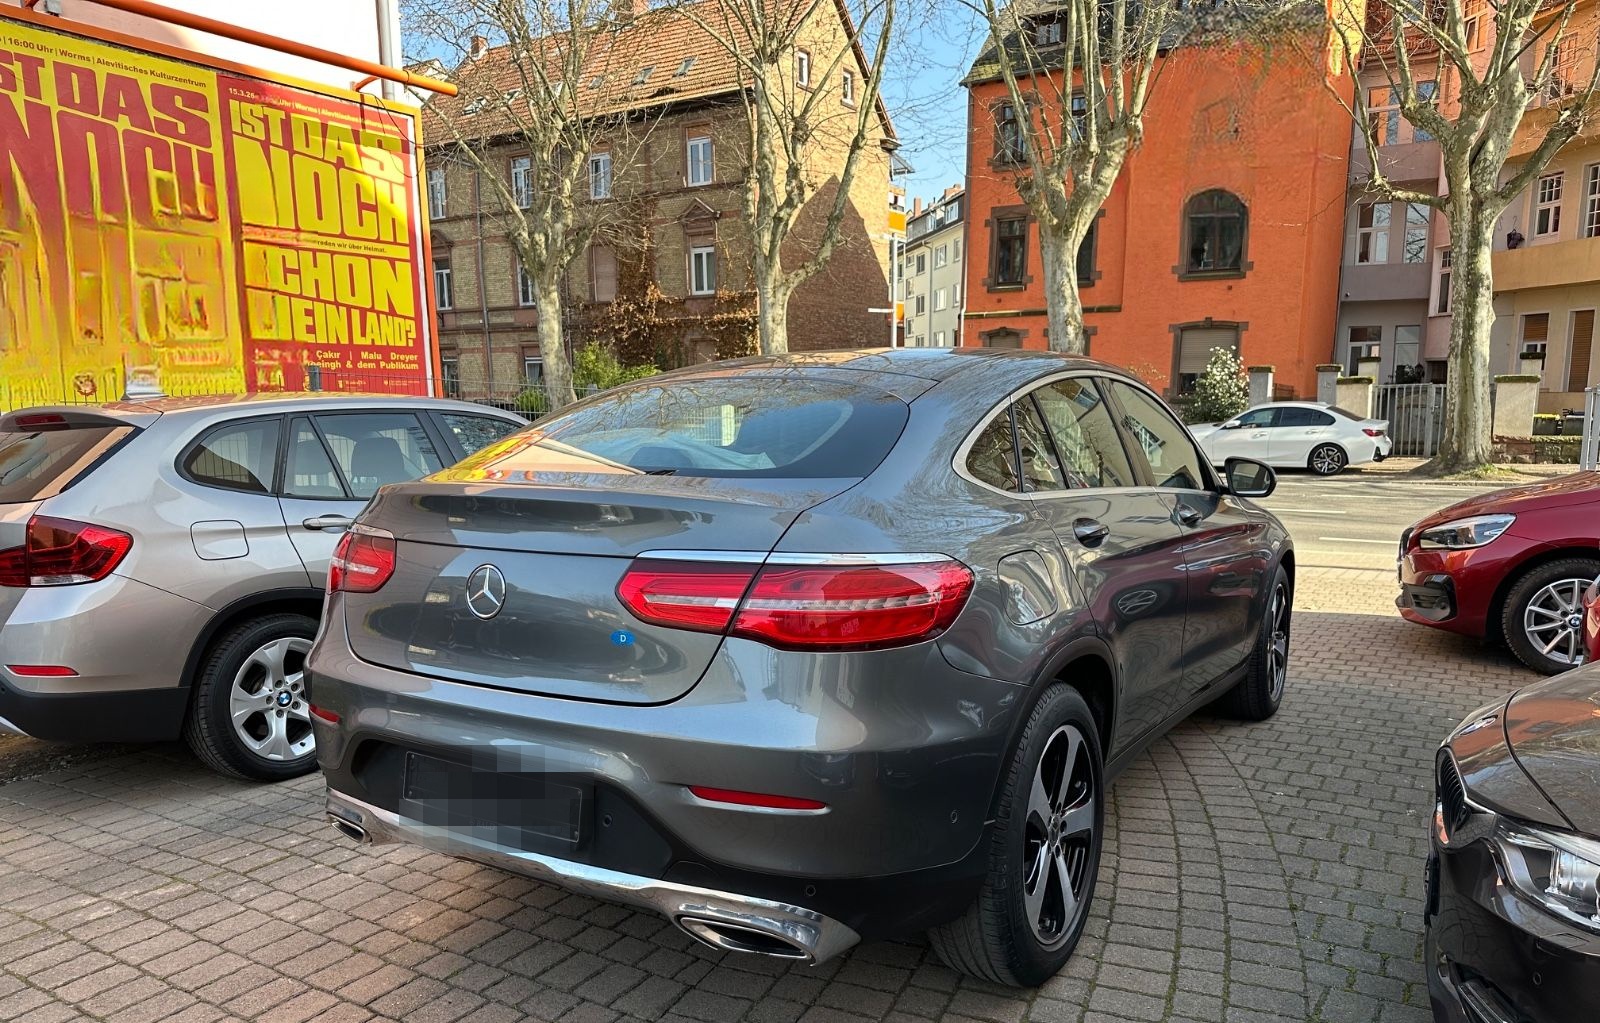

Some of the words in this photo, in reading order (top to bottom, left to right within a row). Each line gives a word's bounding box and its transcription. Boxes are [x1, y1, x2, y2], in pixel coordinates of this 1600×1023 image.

[8, 37, 34, 49] 16:00
[36, 44, 53, 54] Uhr
[59, 48, 90, 61] Worms
[97, 58, 148, 75] Alevitisches
[150, 70, 206, 88] Kulturzentrum
[53, 60, 213, 148] DAS
[229, 99, 285, 147] IST
[290, 112, 405, 185] DAS
[232, 134, 409, 244] NOCH
[317, 240, 336, 248] reden
[352, 309, 416, 347] LAND?
[346, 360, 353, 369] &
[357, 361, 376, 369] dem
[380, 361, 419, 370] Publikum
[361, 351, 382, 360] Malu
[390, 352, 418, 362] Dreyer
